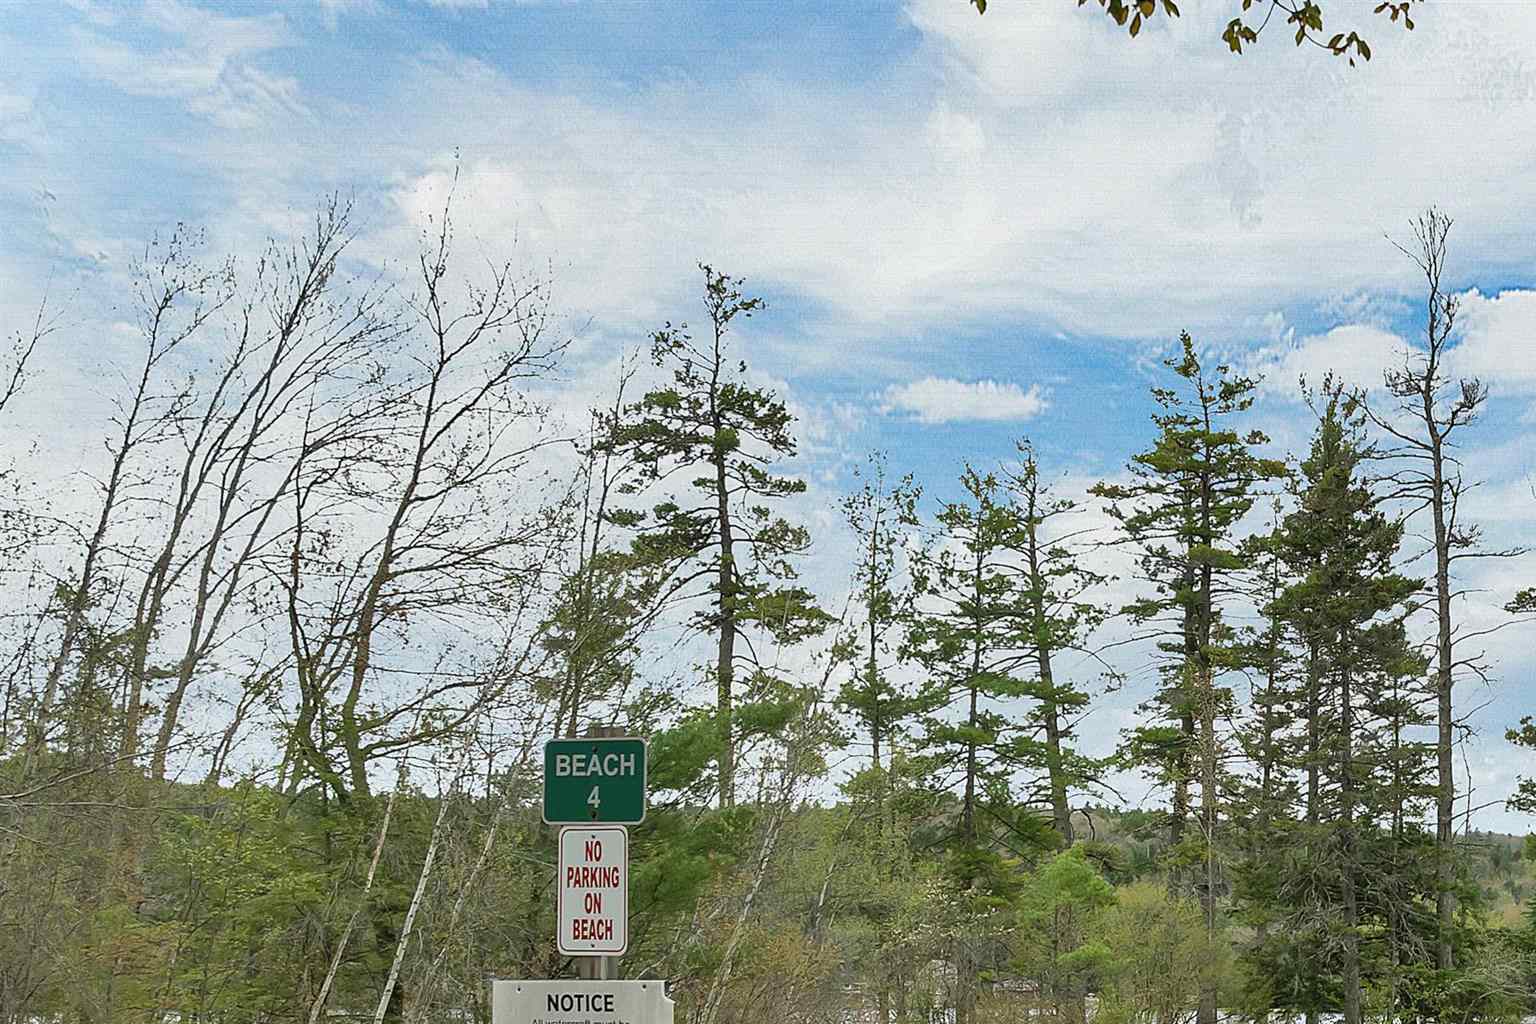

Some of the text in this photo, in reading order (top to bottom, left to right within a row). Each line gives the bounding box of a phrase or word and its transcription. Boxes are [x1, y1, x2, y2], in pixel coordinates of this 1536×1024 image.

[555, 754, 635, 777] BEACH
[587, 785, 600, 808] 4
[585, 840, 602, 862] NO
[567, 866, 619, 888] PARKING
[584, 893, 601, 914] ON
[572, 919, 613, 940] BEACH
[547, 994, 615, 1012] NOTICE
